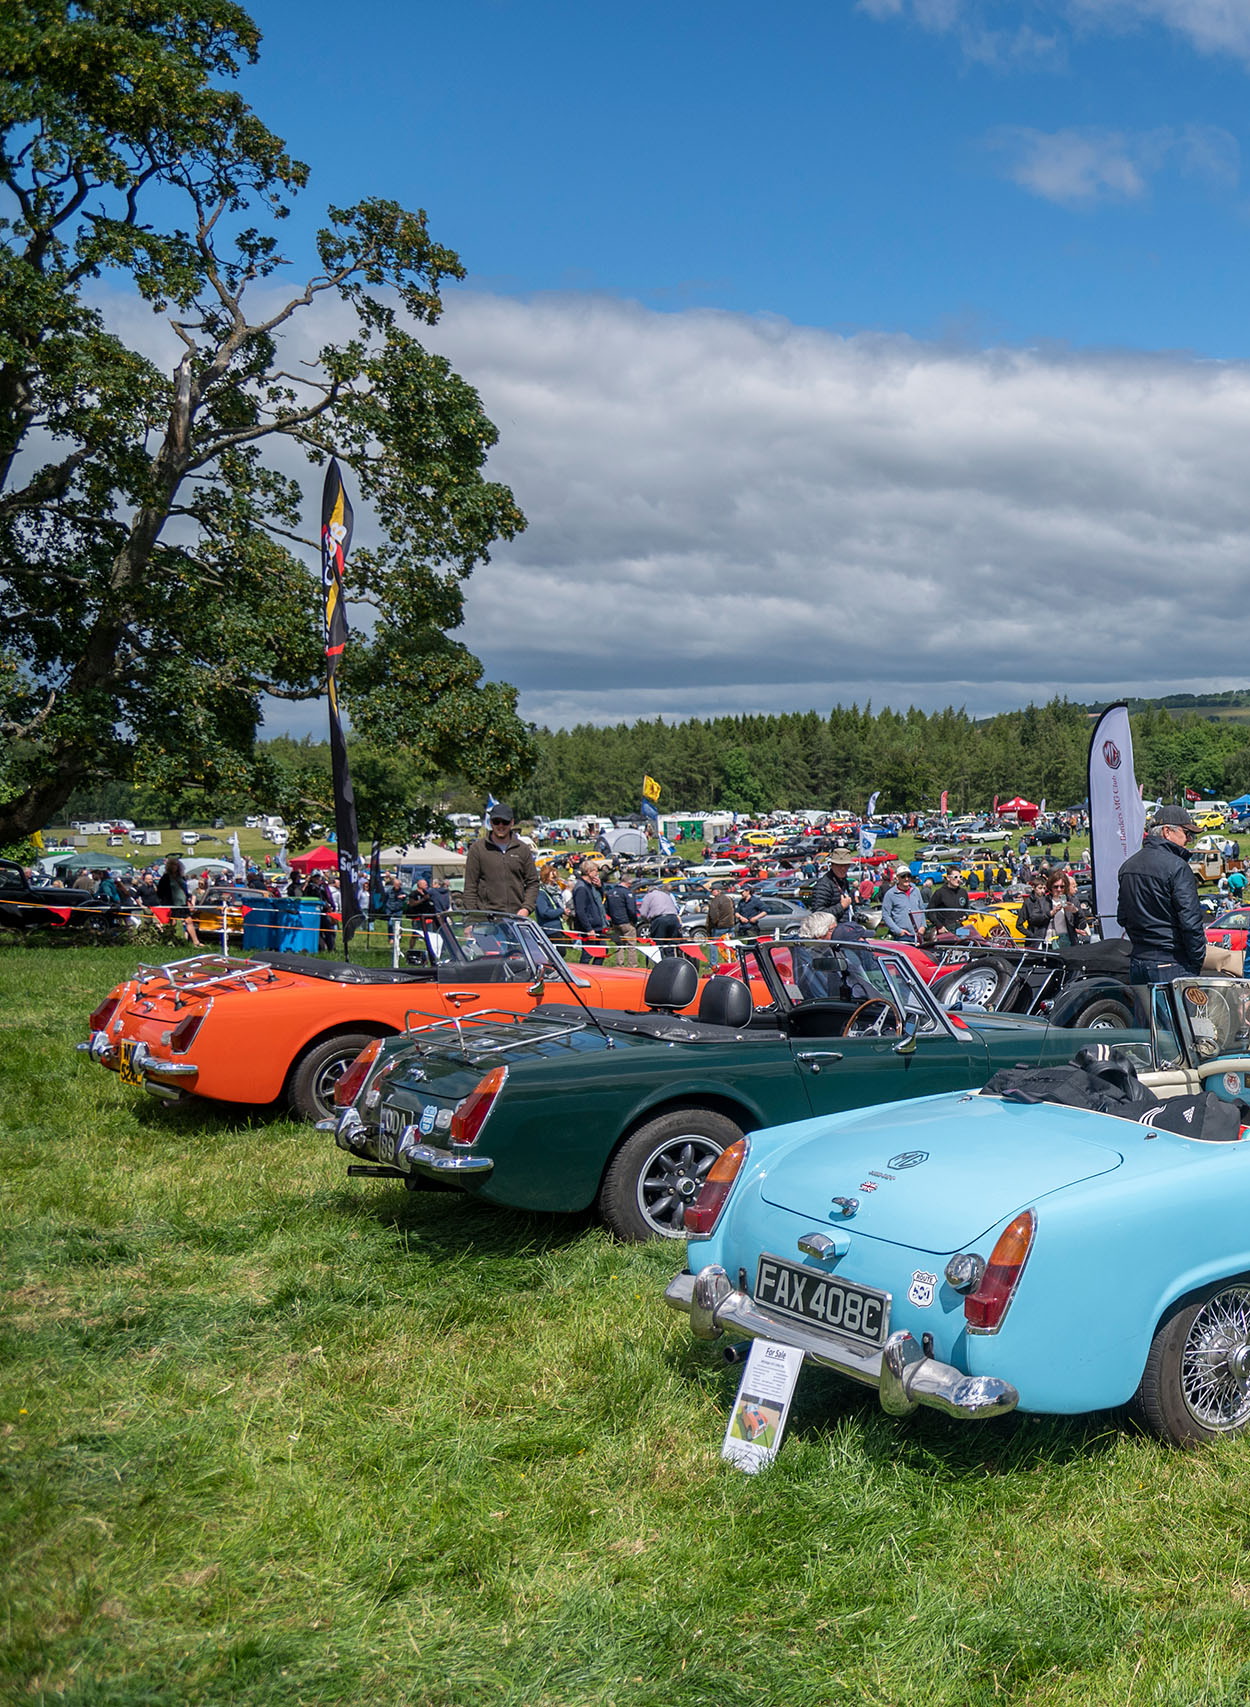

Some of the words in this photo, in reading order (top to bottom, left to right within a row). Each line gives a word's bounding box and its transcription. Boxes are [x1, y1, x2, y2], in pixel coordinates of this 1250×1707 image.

[1189, 989, 1205, 1002] MG
[893, 1151, 925, 1168] MG
[916, 1273, 934, 1284] ROUTE
[758, 1262, 808, 1313] FAX
[809, 1281, 882, 1337] 408C
[765, 1347, 775, 1357] For
[775, 1348, 787, 1360] Sale
